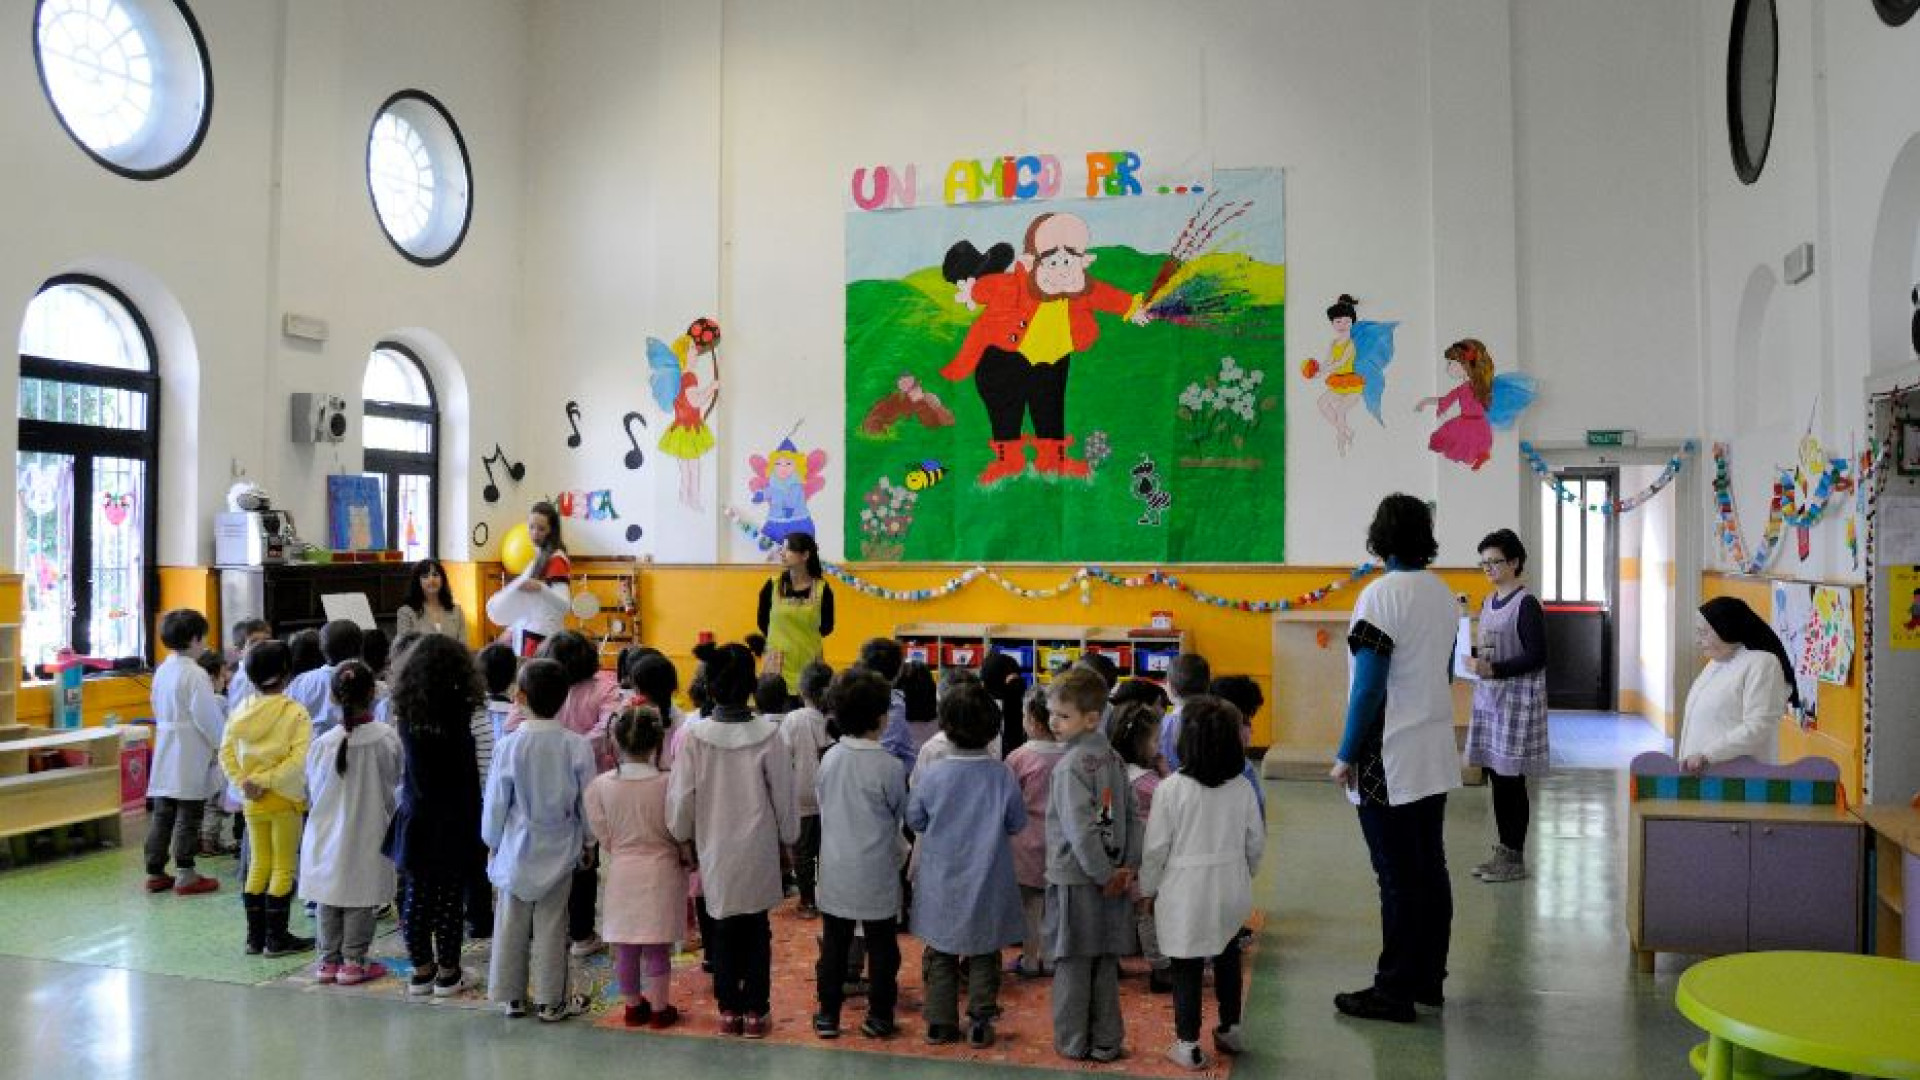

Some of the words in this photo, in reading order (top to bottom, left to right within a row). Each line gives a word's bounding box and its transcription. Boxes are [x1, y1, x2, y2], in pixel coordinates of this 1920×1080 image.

[851, 162, 916, 211] UN
[944, 155, 1062, 206] AMICO
[1086, 151, 1143, 197] PER
